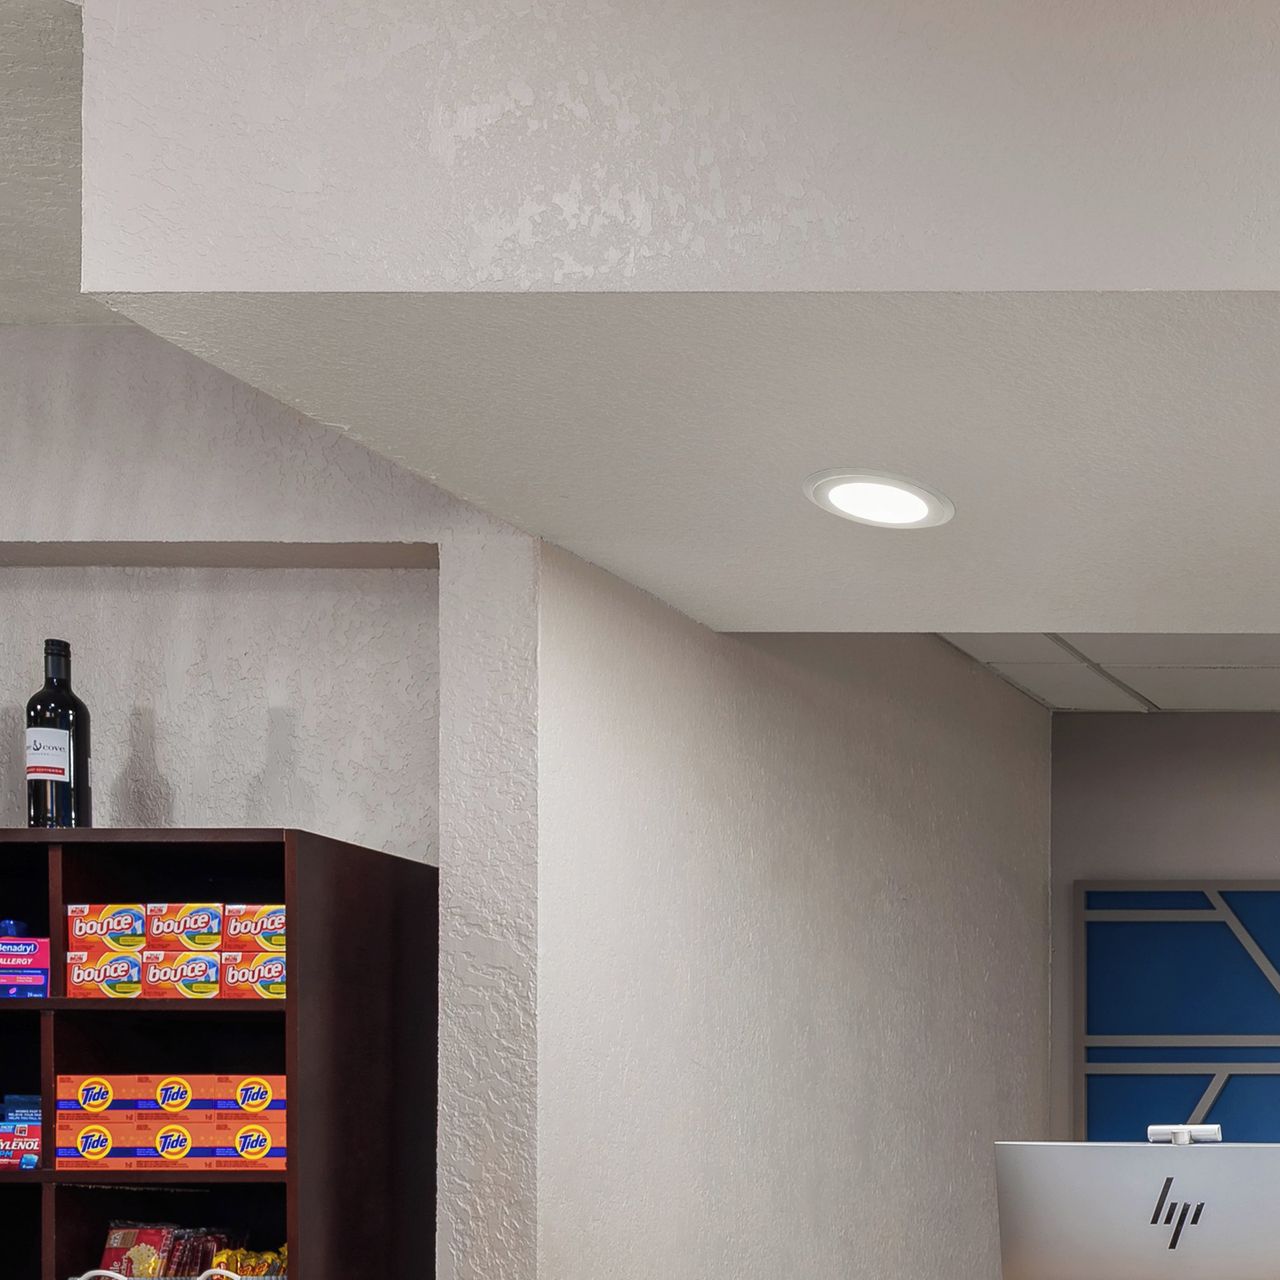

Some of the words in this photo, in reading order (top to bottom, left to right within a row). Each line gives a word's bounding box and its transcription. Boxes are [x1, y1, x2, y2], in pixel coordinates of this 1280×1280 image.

[74, 915, 132, 936] bounce
[152, 914, 209, 935] bounce
[228, 914, 285, 935] bounce
[72, 962, 130, 984] bounce
[148, 962, 207, 984] bounce
[226, 962, 283, 984] bounce
[81, 1085, 109, 1106] Tide
[160, 1085, 188, 1106] Tide
[240, 1085, 268, 1106] Tide
[0, 1141, 39, 1150] YLENOL
[80, 1133, 108, 1154] Tide
[159, 1133, 188, 1154] Tide
[239, 1133, 267, 1154] Tide
